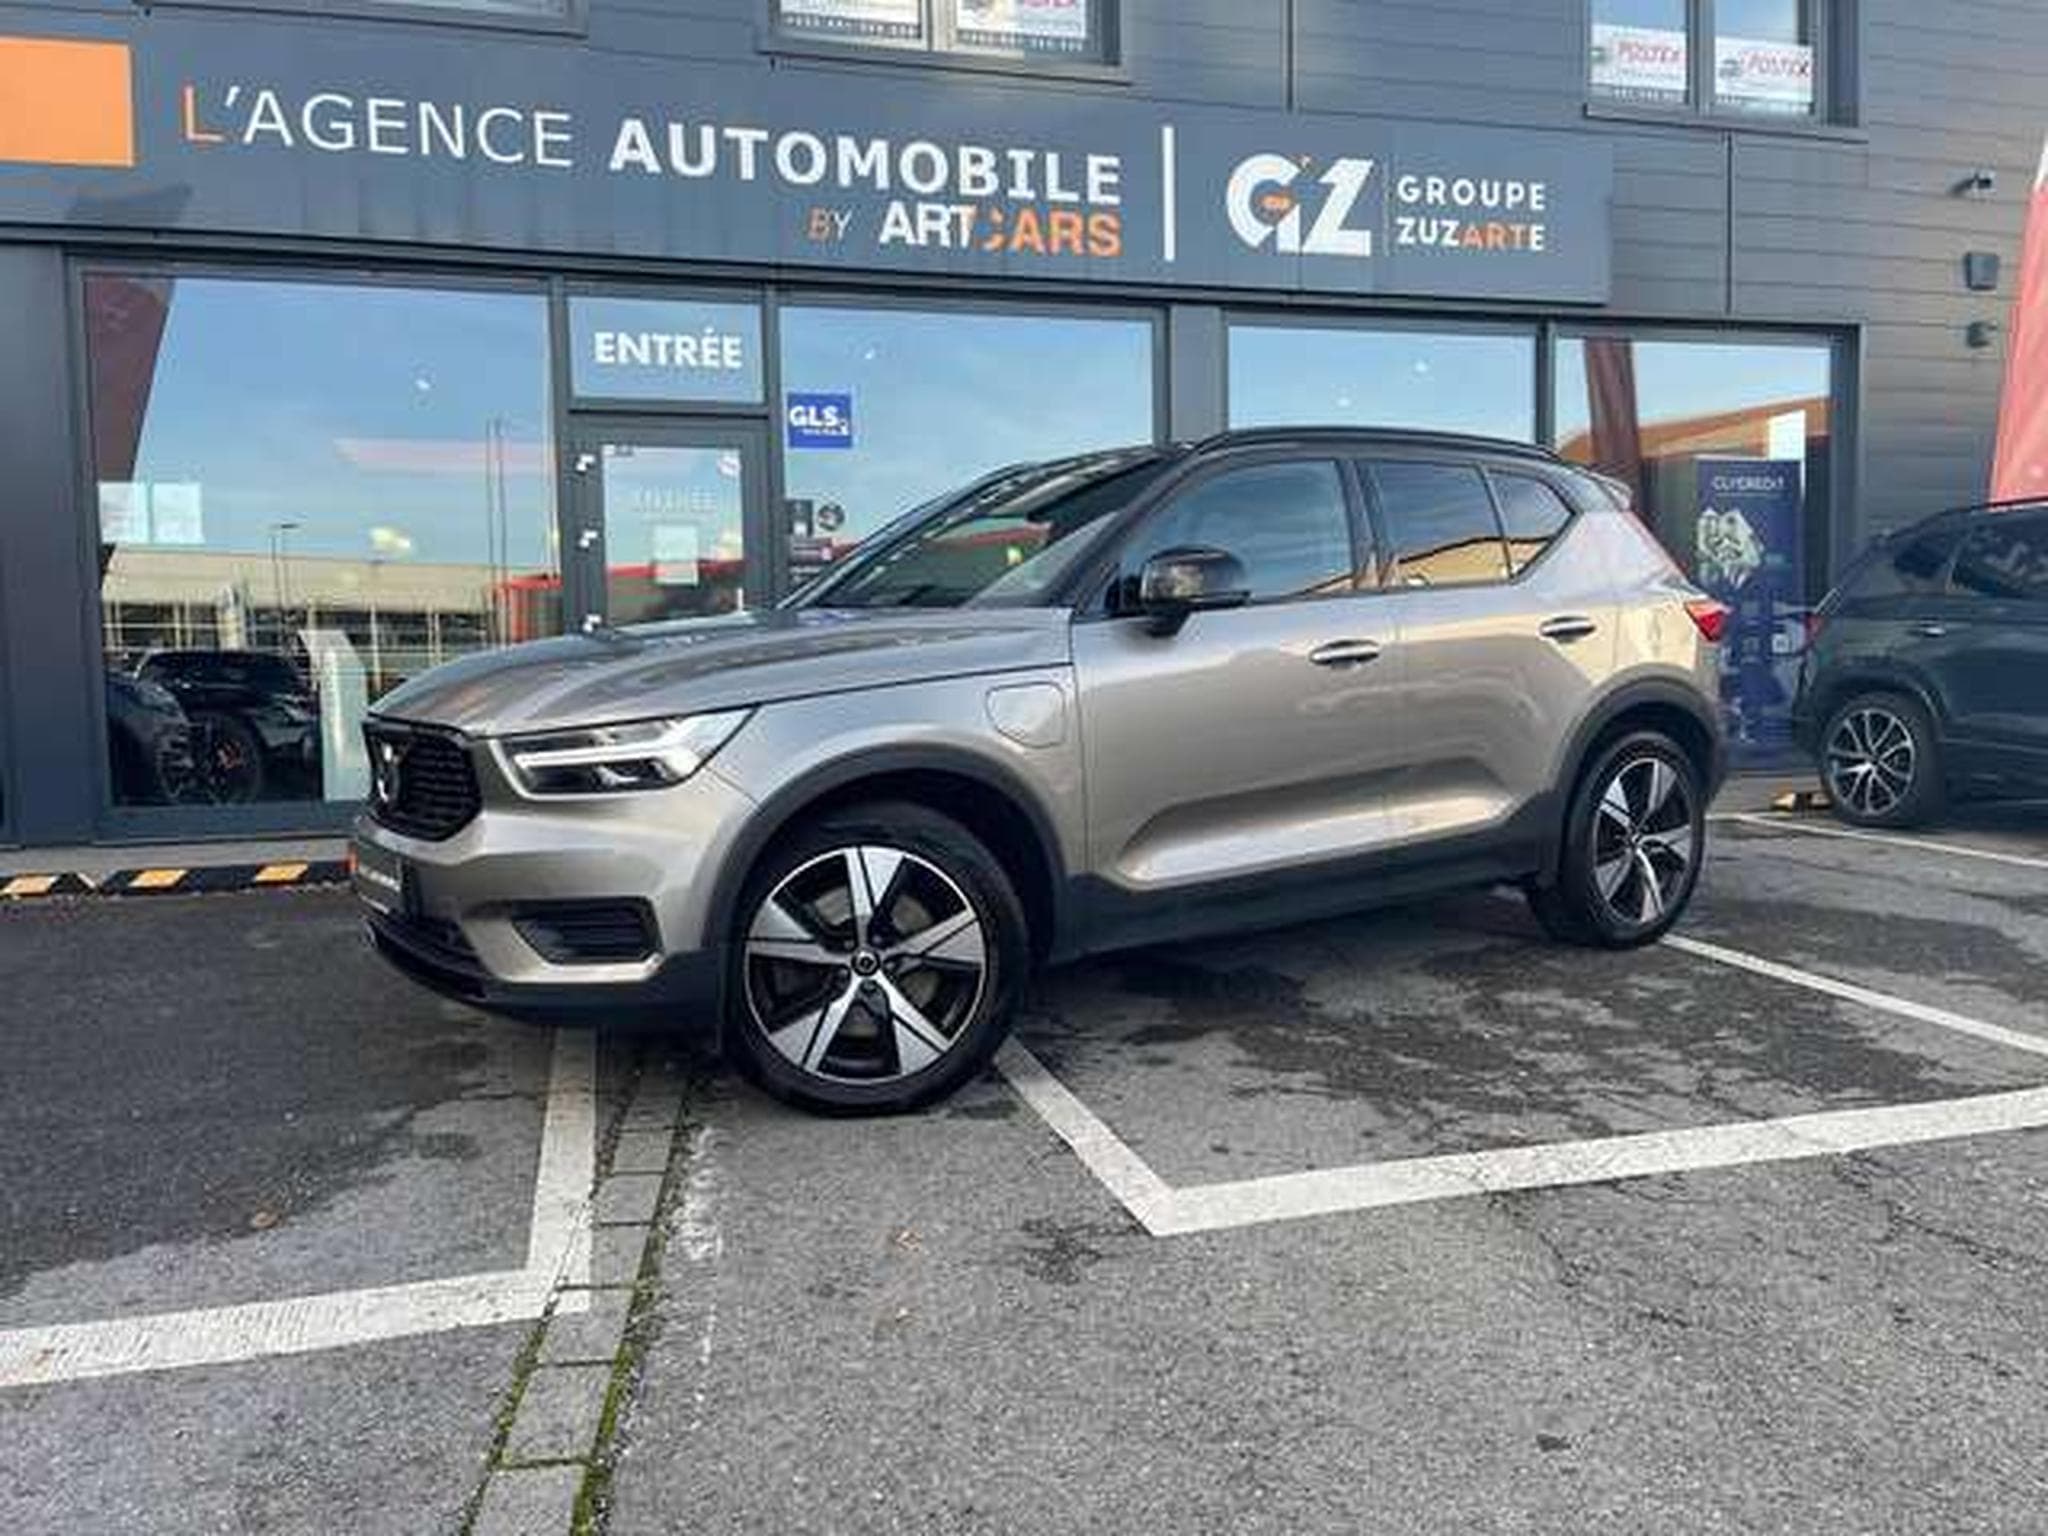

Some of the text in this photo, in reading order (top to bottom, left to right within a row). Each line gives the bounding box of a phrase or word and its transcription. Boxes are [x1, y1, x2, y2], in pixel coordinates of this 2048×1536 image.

[182, 83, 1122, 206] L'AGENCE AUTOMOBILE
[1397, 173, 1547, 211] GROUPE
[808, 207, 853, 241] BY
[1396, 216, 1547, 251] ZUZARTE
[593, 326, 743, 369] ENTRÉE
[789, 405, 839, 428] GLS
